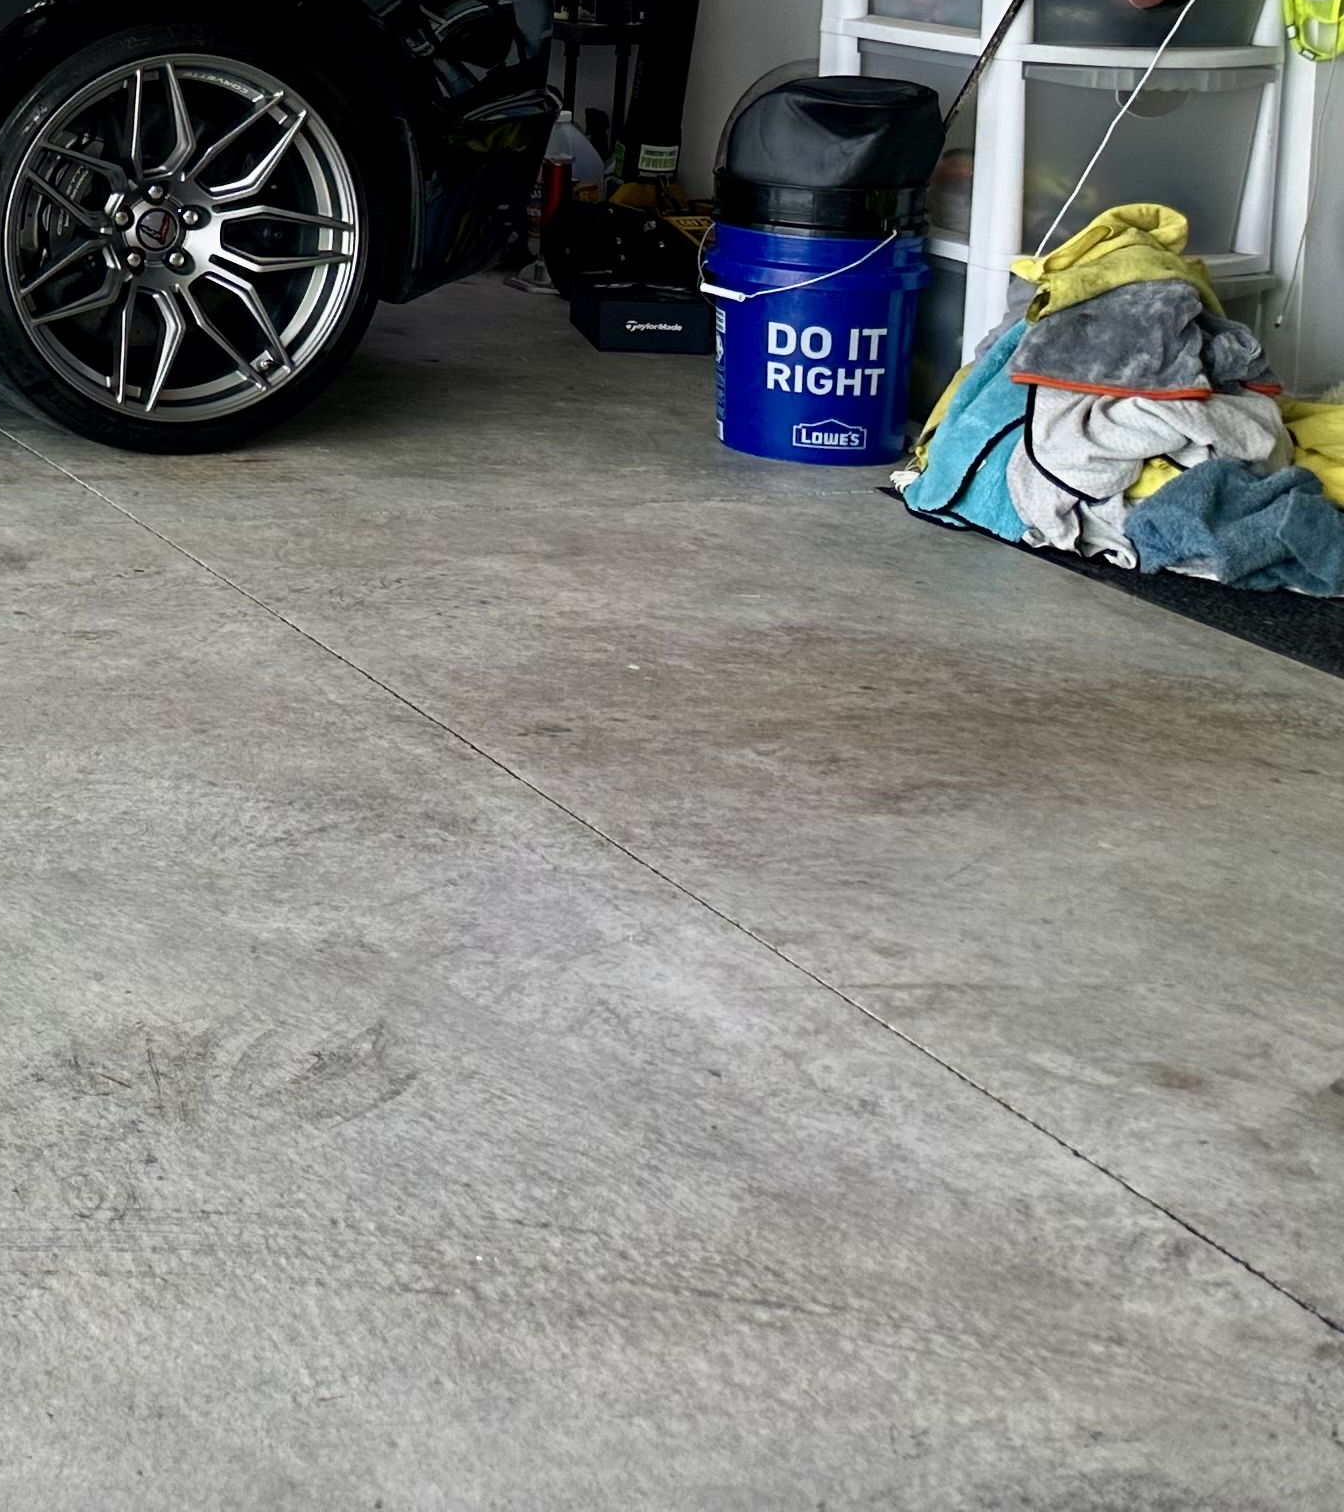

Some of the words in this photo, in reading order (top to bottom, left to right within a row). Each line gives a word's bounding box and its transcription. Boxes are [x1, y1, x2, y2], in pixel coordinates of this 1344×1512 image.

[625, 319, 684, 333] TaylorMade
[767, 322, 833, 361] DO
[848, 327, 888, 362] IT
[766, 362, 886, 397] RIGHT
[800, 428, 860, 447] LOWE'S
